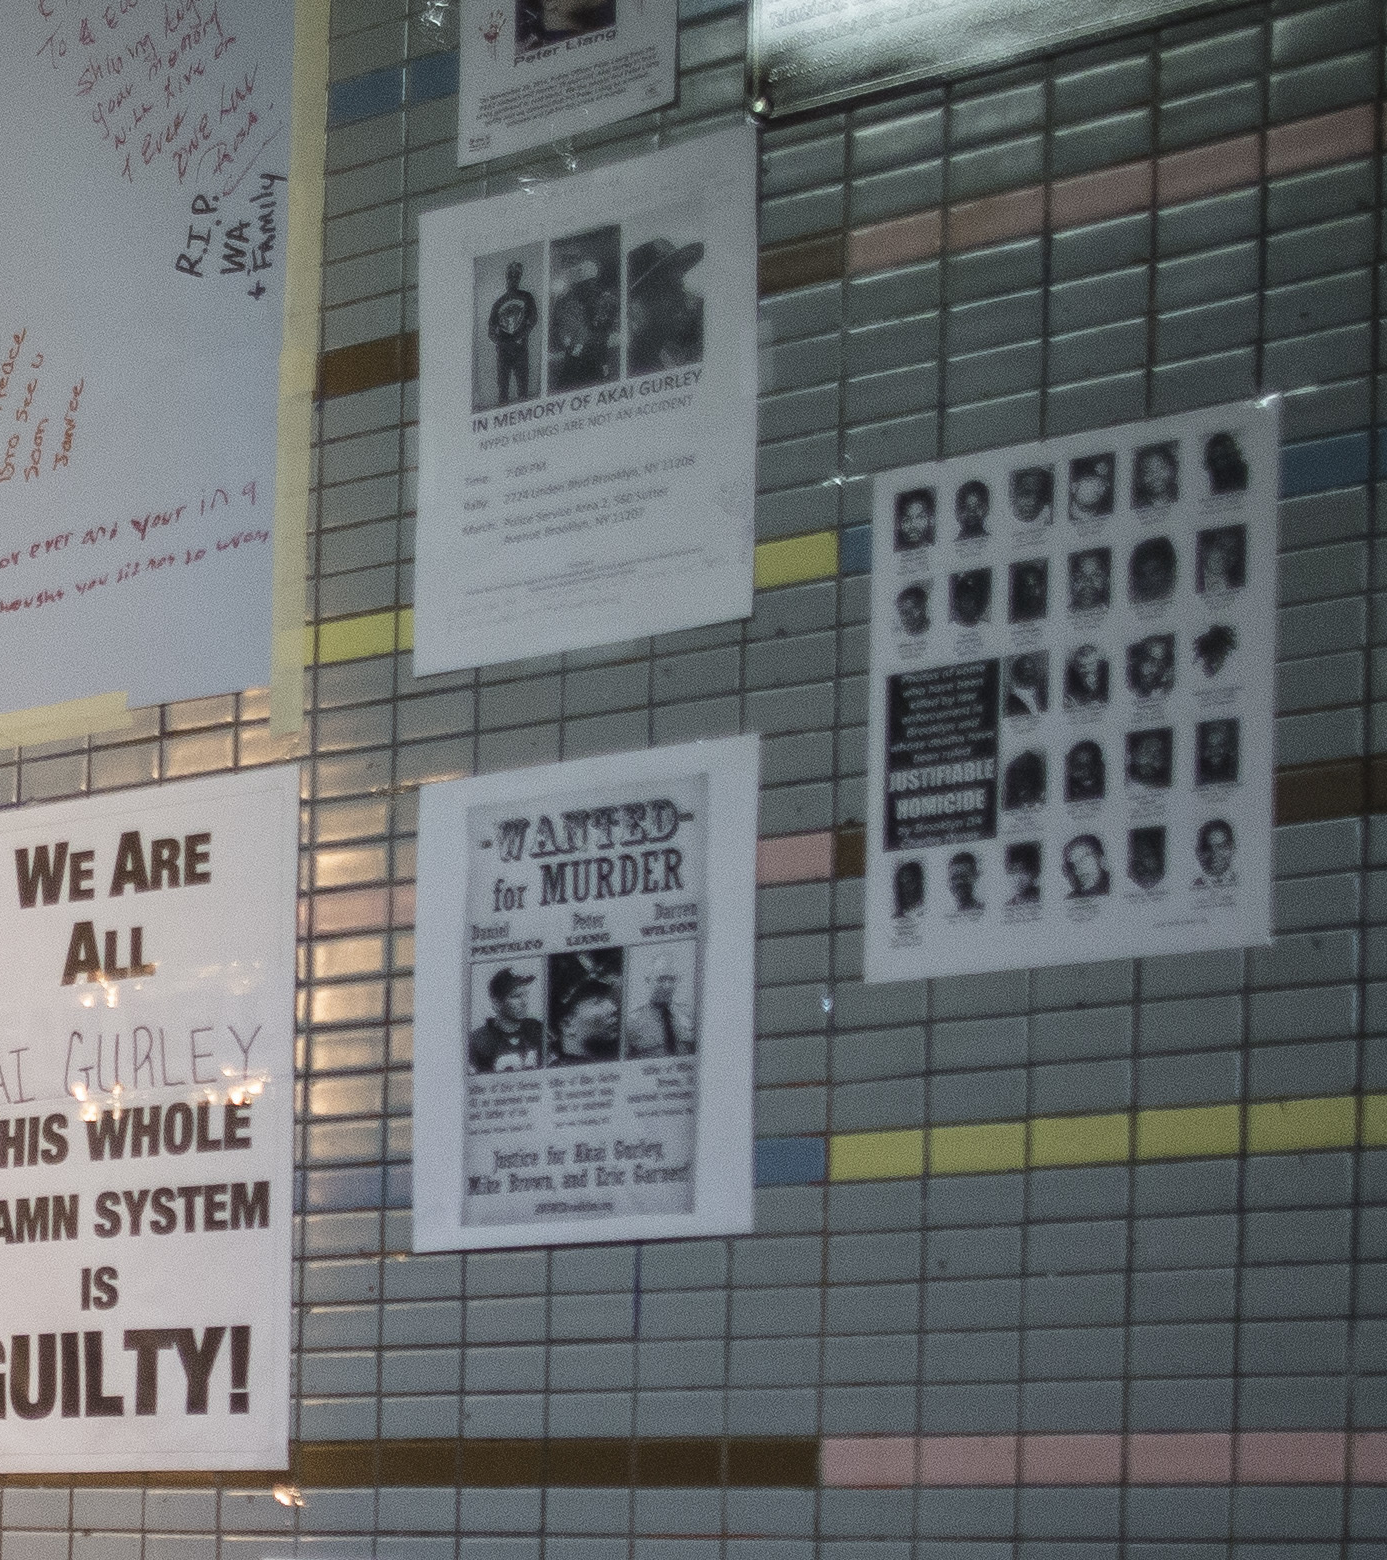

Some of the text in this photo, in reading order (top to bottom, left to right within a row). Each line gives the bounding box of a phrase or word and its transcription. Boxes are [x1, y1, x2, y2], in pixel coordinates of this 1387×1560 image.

[514, 27, 618, 67] Peter Liang
[471, 370, 703, 433] IN MEMORY OF AKAI GURLEY
[512, 423, 560, 444] KILLINGS
[563, 419, 585, 432] ARE
[587, 412, 613, 428] NOT
[615, 408, 633, 421] AN
[635, 394, 694, 416] ACCIDENT
[888, 758, 995, 793] JUSTIFIABLE
[896, 788, 986, 820] HOMICIDE
[498, 797, 682, 863] WANTED
[492, 848, 685, 913] for MURDER
[63, 1022, 265, 1101] GURLEY
[86, 1097, 253, 1163] WHOLE
[93, 1180, 272, 1240] SYSTEM
[79, 1264, 120, 1313] IS
